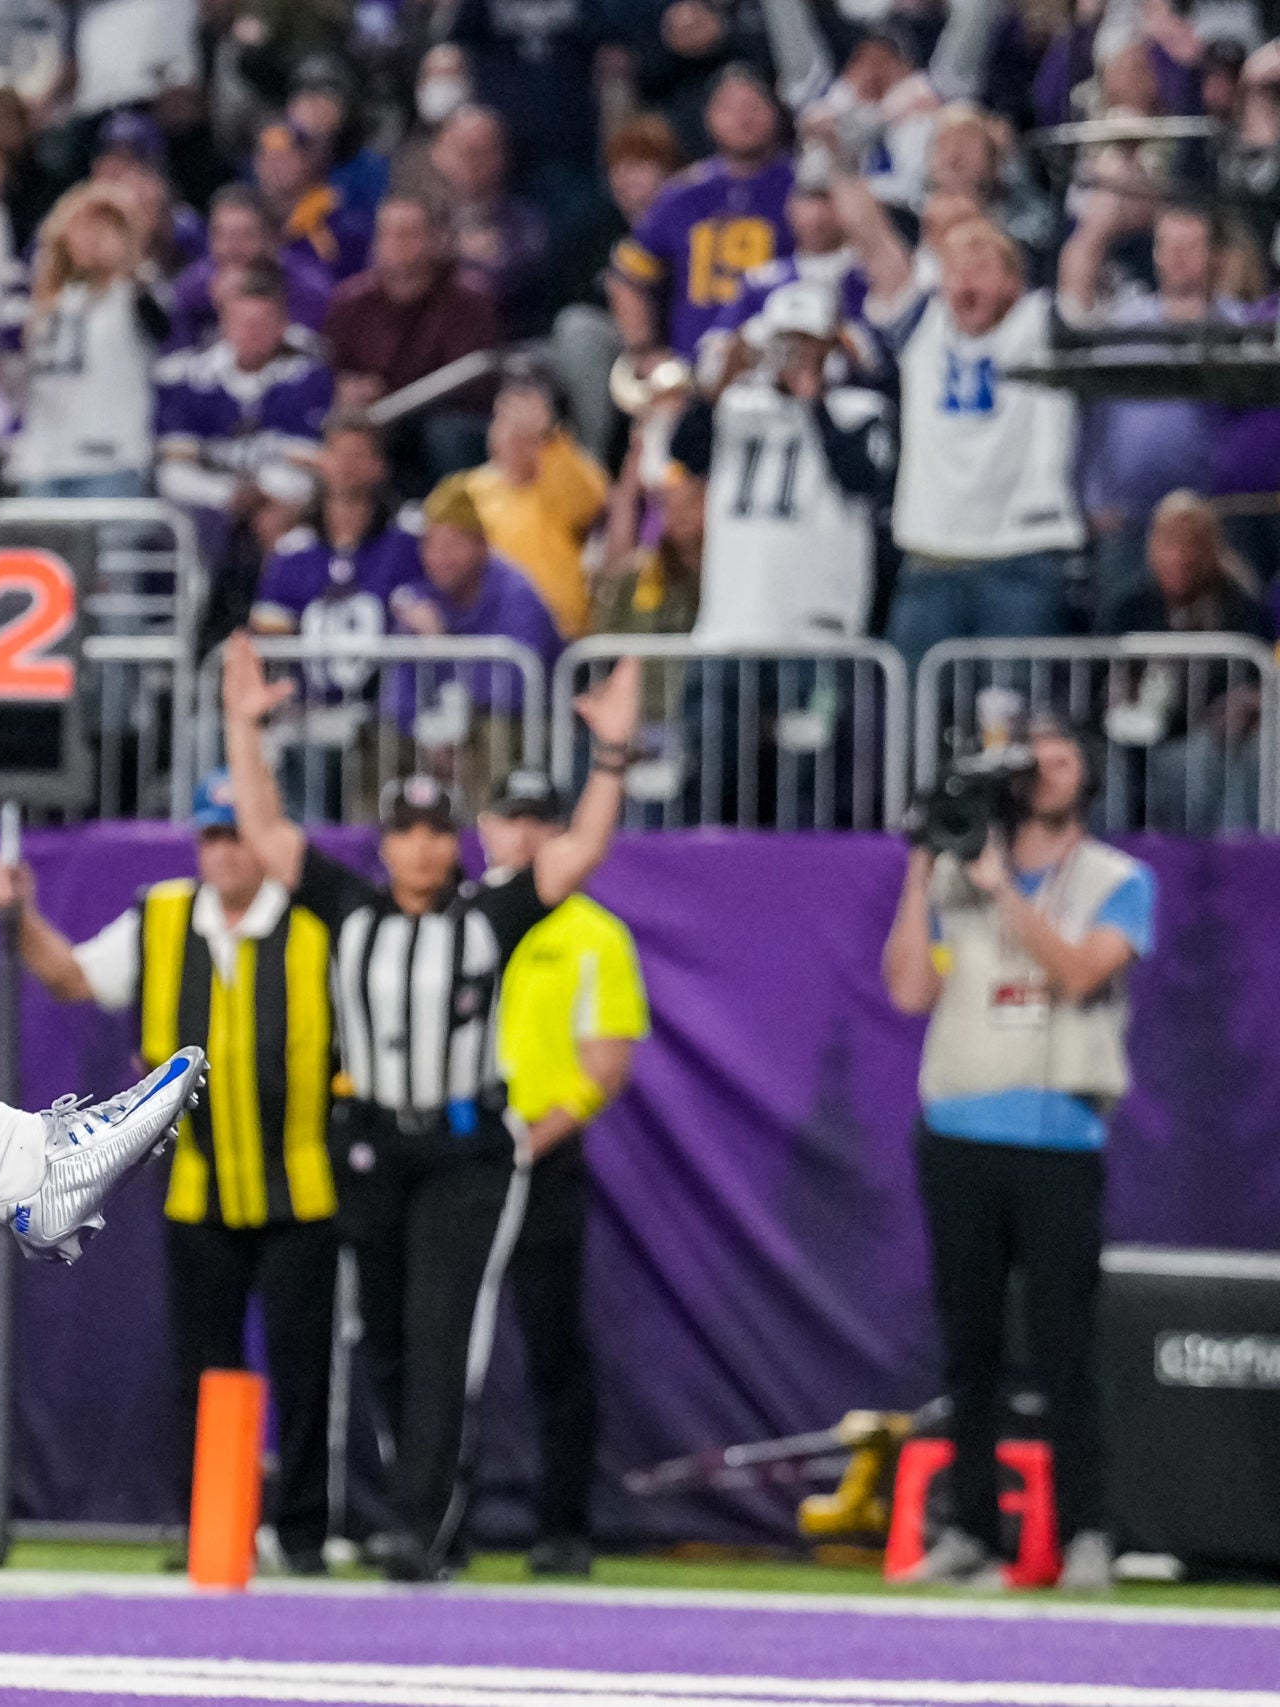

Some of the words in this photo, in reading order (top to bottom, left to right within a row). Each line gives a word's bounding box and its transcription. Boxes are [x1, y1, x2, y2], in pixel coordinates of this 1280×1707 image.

[687, 217, 775, 308] 19
[734, 434, 803, 518] 11
[14, 1202, 31, 1238] NIKE
